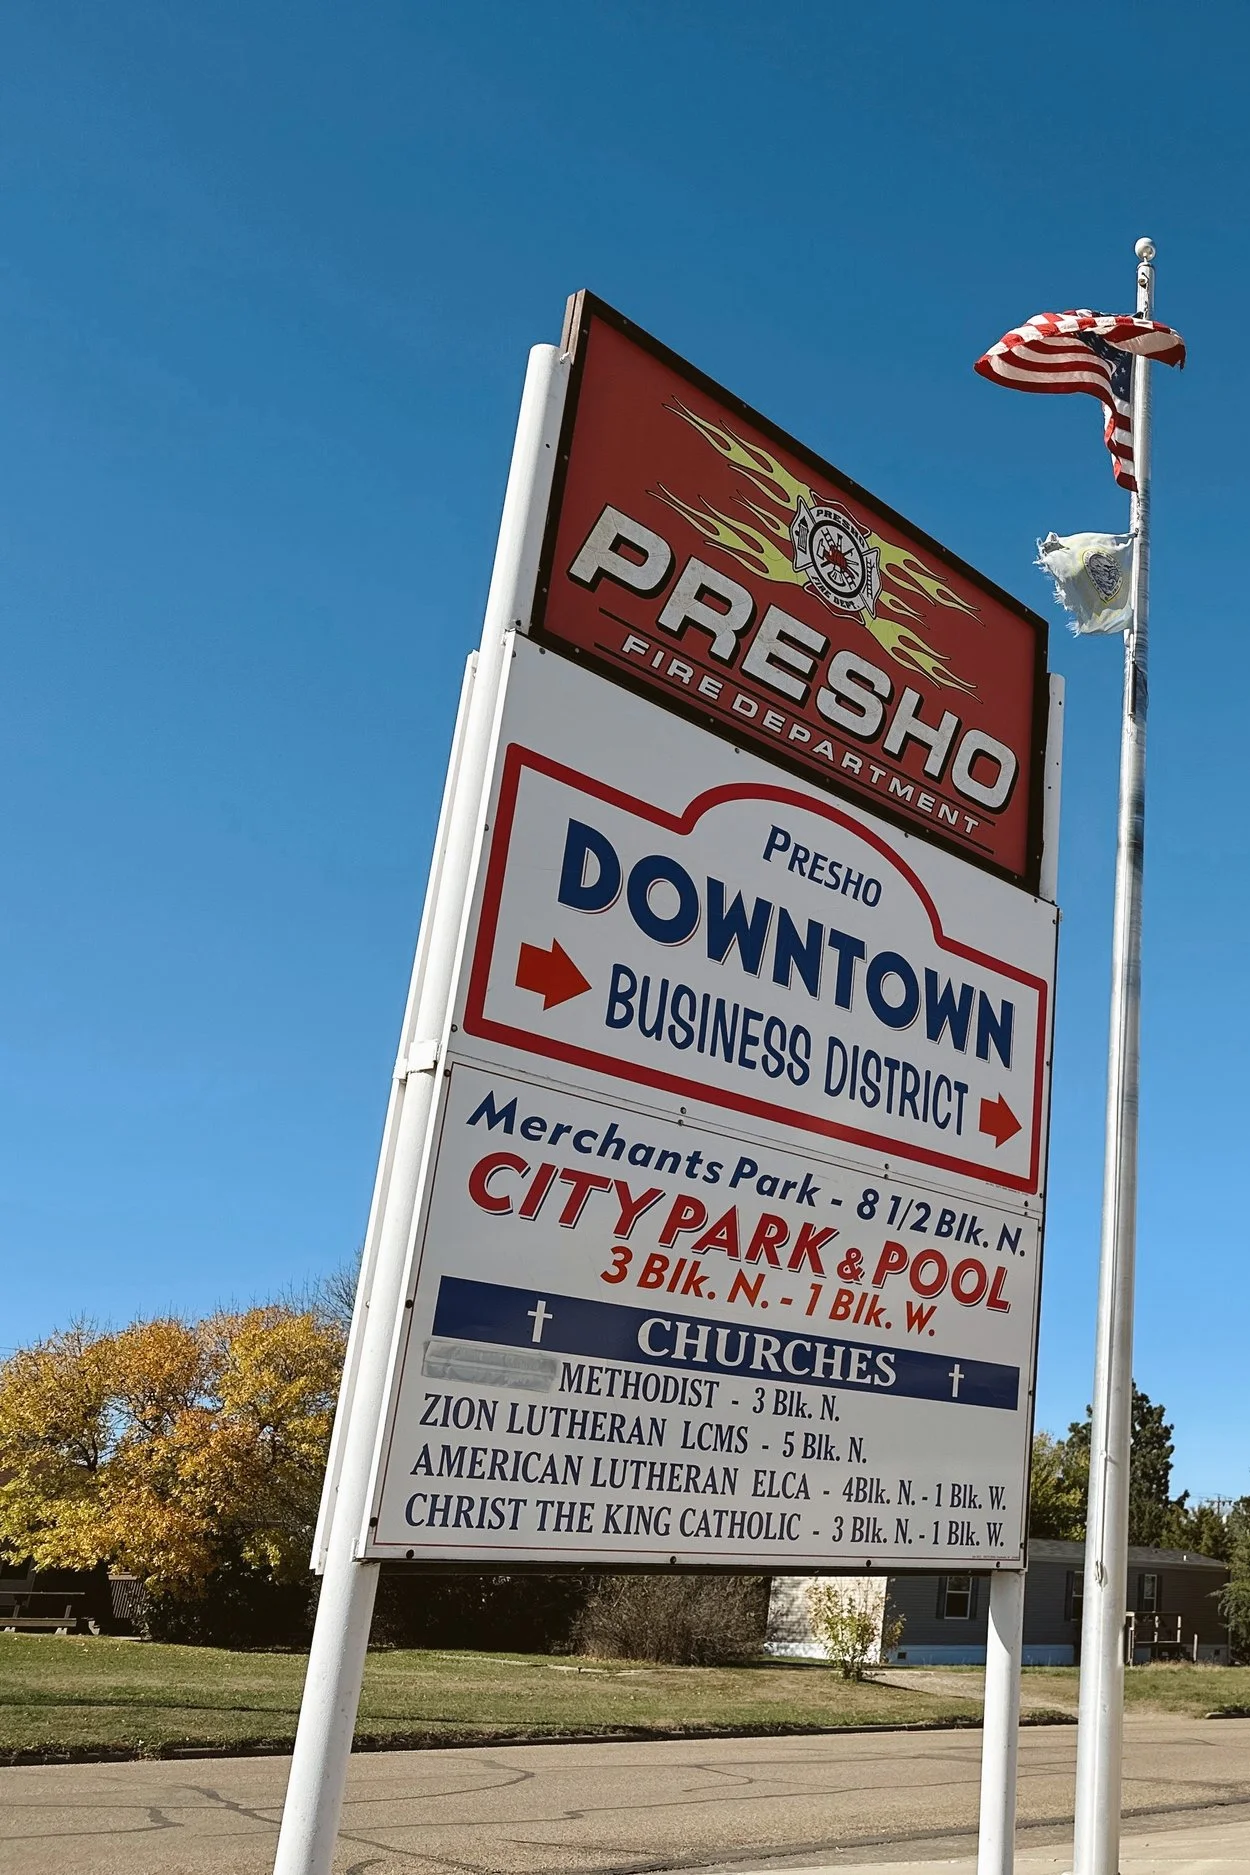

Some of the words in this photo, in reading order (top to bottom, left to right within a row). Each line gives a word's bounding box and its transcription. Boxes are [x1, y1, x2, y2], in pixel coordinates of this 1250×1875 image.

[816, 509, 865, 548] PRESHO
[811, 575, 832, 599] FIRE
[569, 503, 1019, 814] PRESHO
[620, 634, 722, 701] FIRE
[731, 698, 982, 836] DEPARTMENT
[762, 824, 883, 909] PRESHO
[557, 817, 1015, 1071] DOWNTOWN
[605, 963, 812, 1087] BUSINESS
[823, 1036, 970, 1136] DISTRICT
[466, 1090, 724, 1184] Merchants
[728, 1156, 821, 1208] Park
[856, 1188, 880, 1221] 8
[886, 1195, 932, 1233] 1/2
[934, 1208, 989, 1249] Blk.
[996, 1223, 1026, 1257] N.
[468, 1151, 666, 1240] CITY
[658, 1194, 840, 1278] PARK
[837, 1247, 864, 1285] &
[871, 1240, 1012, 1313] POOL
[600, 1246, 633, 1285] 3
[637, 1253, 716, 1300] Blk.
[727, 1268, 769, 1309] N.
[805, 1283, 823, 1317] 1
[829, 1288, 892, 1329] Blk.
[906, 1301, 937, 1337] W.
[558, 1362, 720, 1409] METHODIST
[752, 1387, 766, 1414] 3
[772, 1389, 813, 1419] Blk.
[820, 1394, 840, 1422] N.
[637, 1317, 897, 1387] CHURCHES
[419, 1392, 499, 1432] ZION
[506, 1402, 667, 1447] LUTHERAN
[681, 1420, 748, 1454] LCMS
[782, 1431, 795, 1458] 5
[801, 1432, 841, 1461] Blk.
[848, 1437, 867, 1464] N.
[410, 1443, 584, 1486] AMERICAN
[590, 1457, 739, 1496] LUTHERAN
[751, 1469, 811, 1500] ELCA
[897, 1480, 916, 1506] N.
[934, 1483, 943, 1507] 1
[949, 1483, 982, 1510] Blk.
[988, 1486, 1007, 1511] W.
[405, 1492, 528, 1531] CHRIST
[535, 1499, 595, 1534] THE
[602, 1503, 672, 1537] KING
[679, 1507, 801, 1541] CATHOLIC
[832, 1516, 844, 1543] 3
[850, 1517, 888, 1544] Blk.
[894, 1518, 913, 1545] N.
[932, 1520, 940, 1545] 1
[947, 1520, 980, 1547] Blk.
[986, 1522, 1004, 1548] W.
